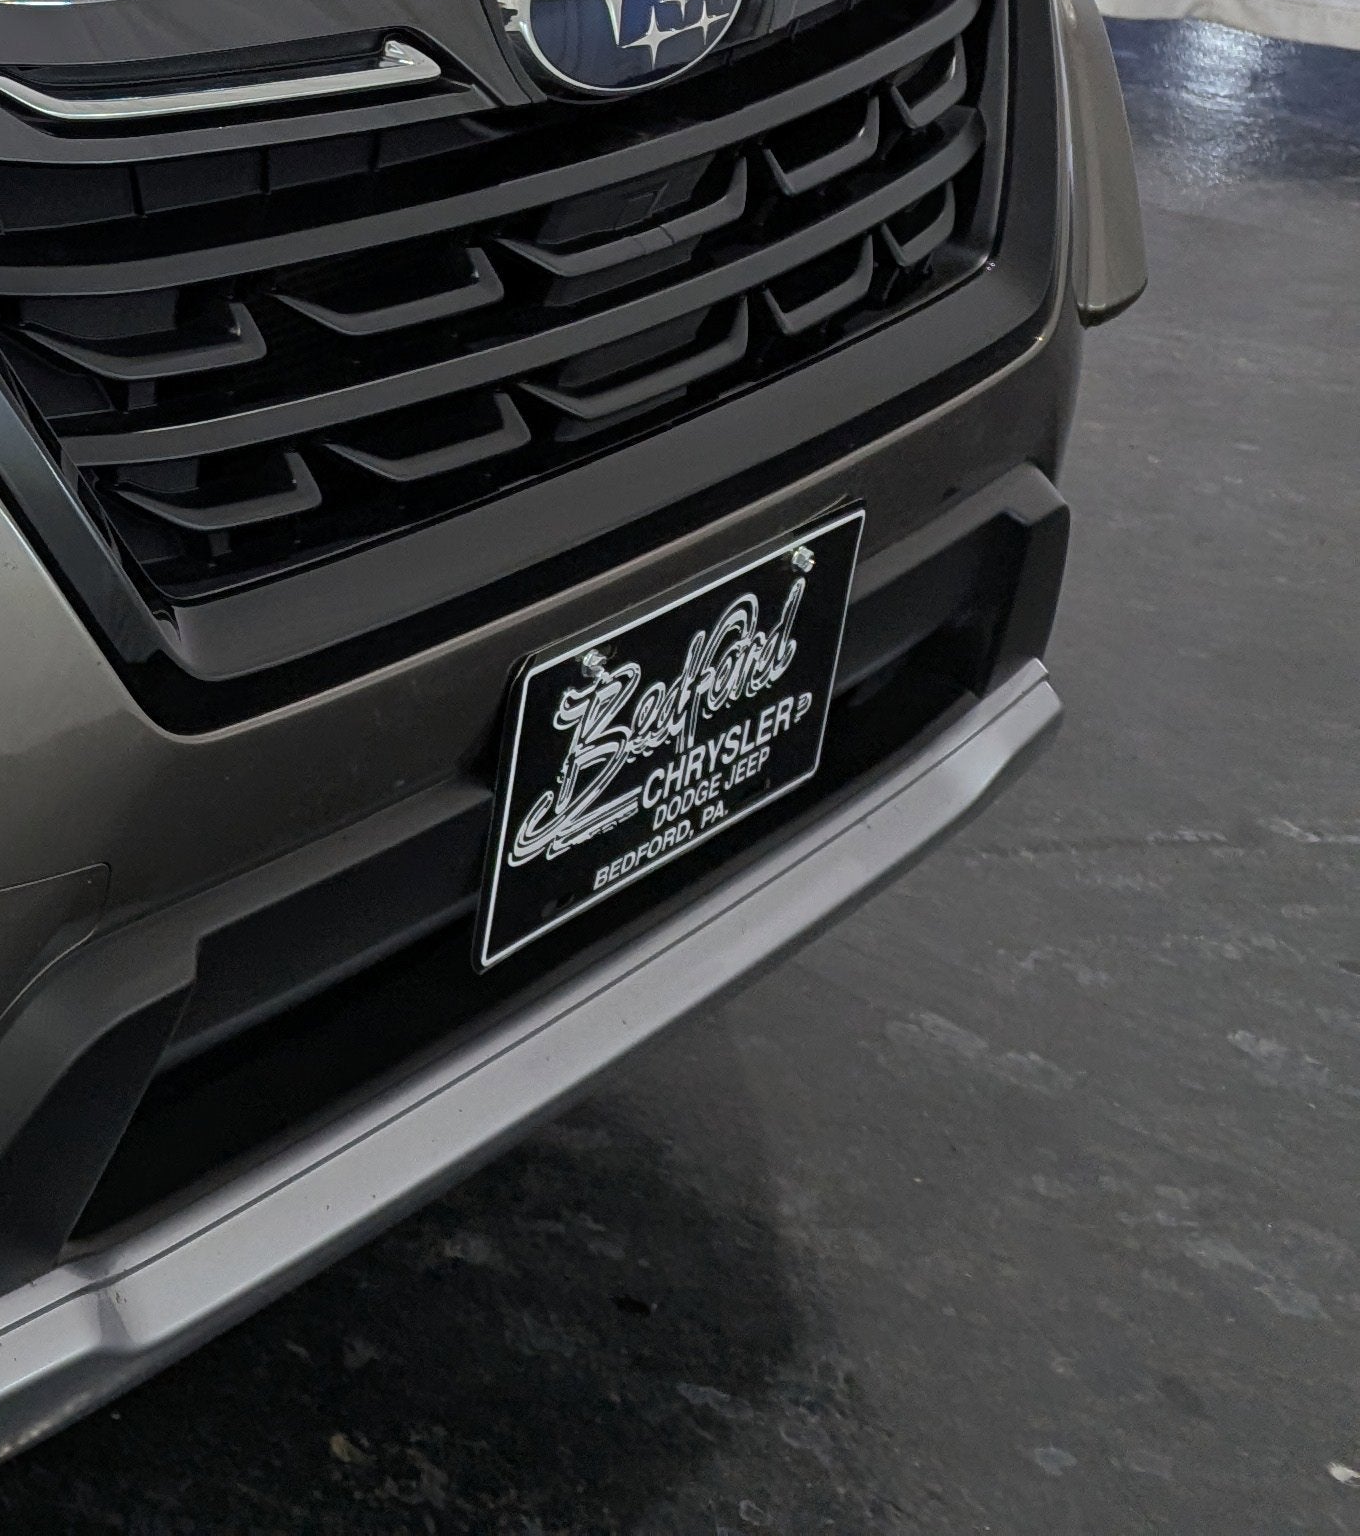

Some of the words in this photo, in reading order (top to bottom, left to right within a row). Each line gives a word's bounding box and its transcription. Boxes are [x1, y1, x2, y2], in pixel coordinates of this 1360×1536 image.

[642, 696, 794, 809] CHRYSLER
[652, 772, 723, 831] DODGE
[723, 745, 771, 791] JEEP
[592, 819, 695, 892] BEDFORD,
[700, 800, 730, 830] PA.
